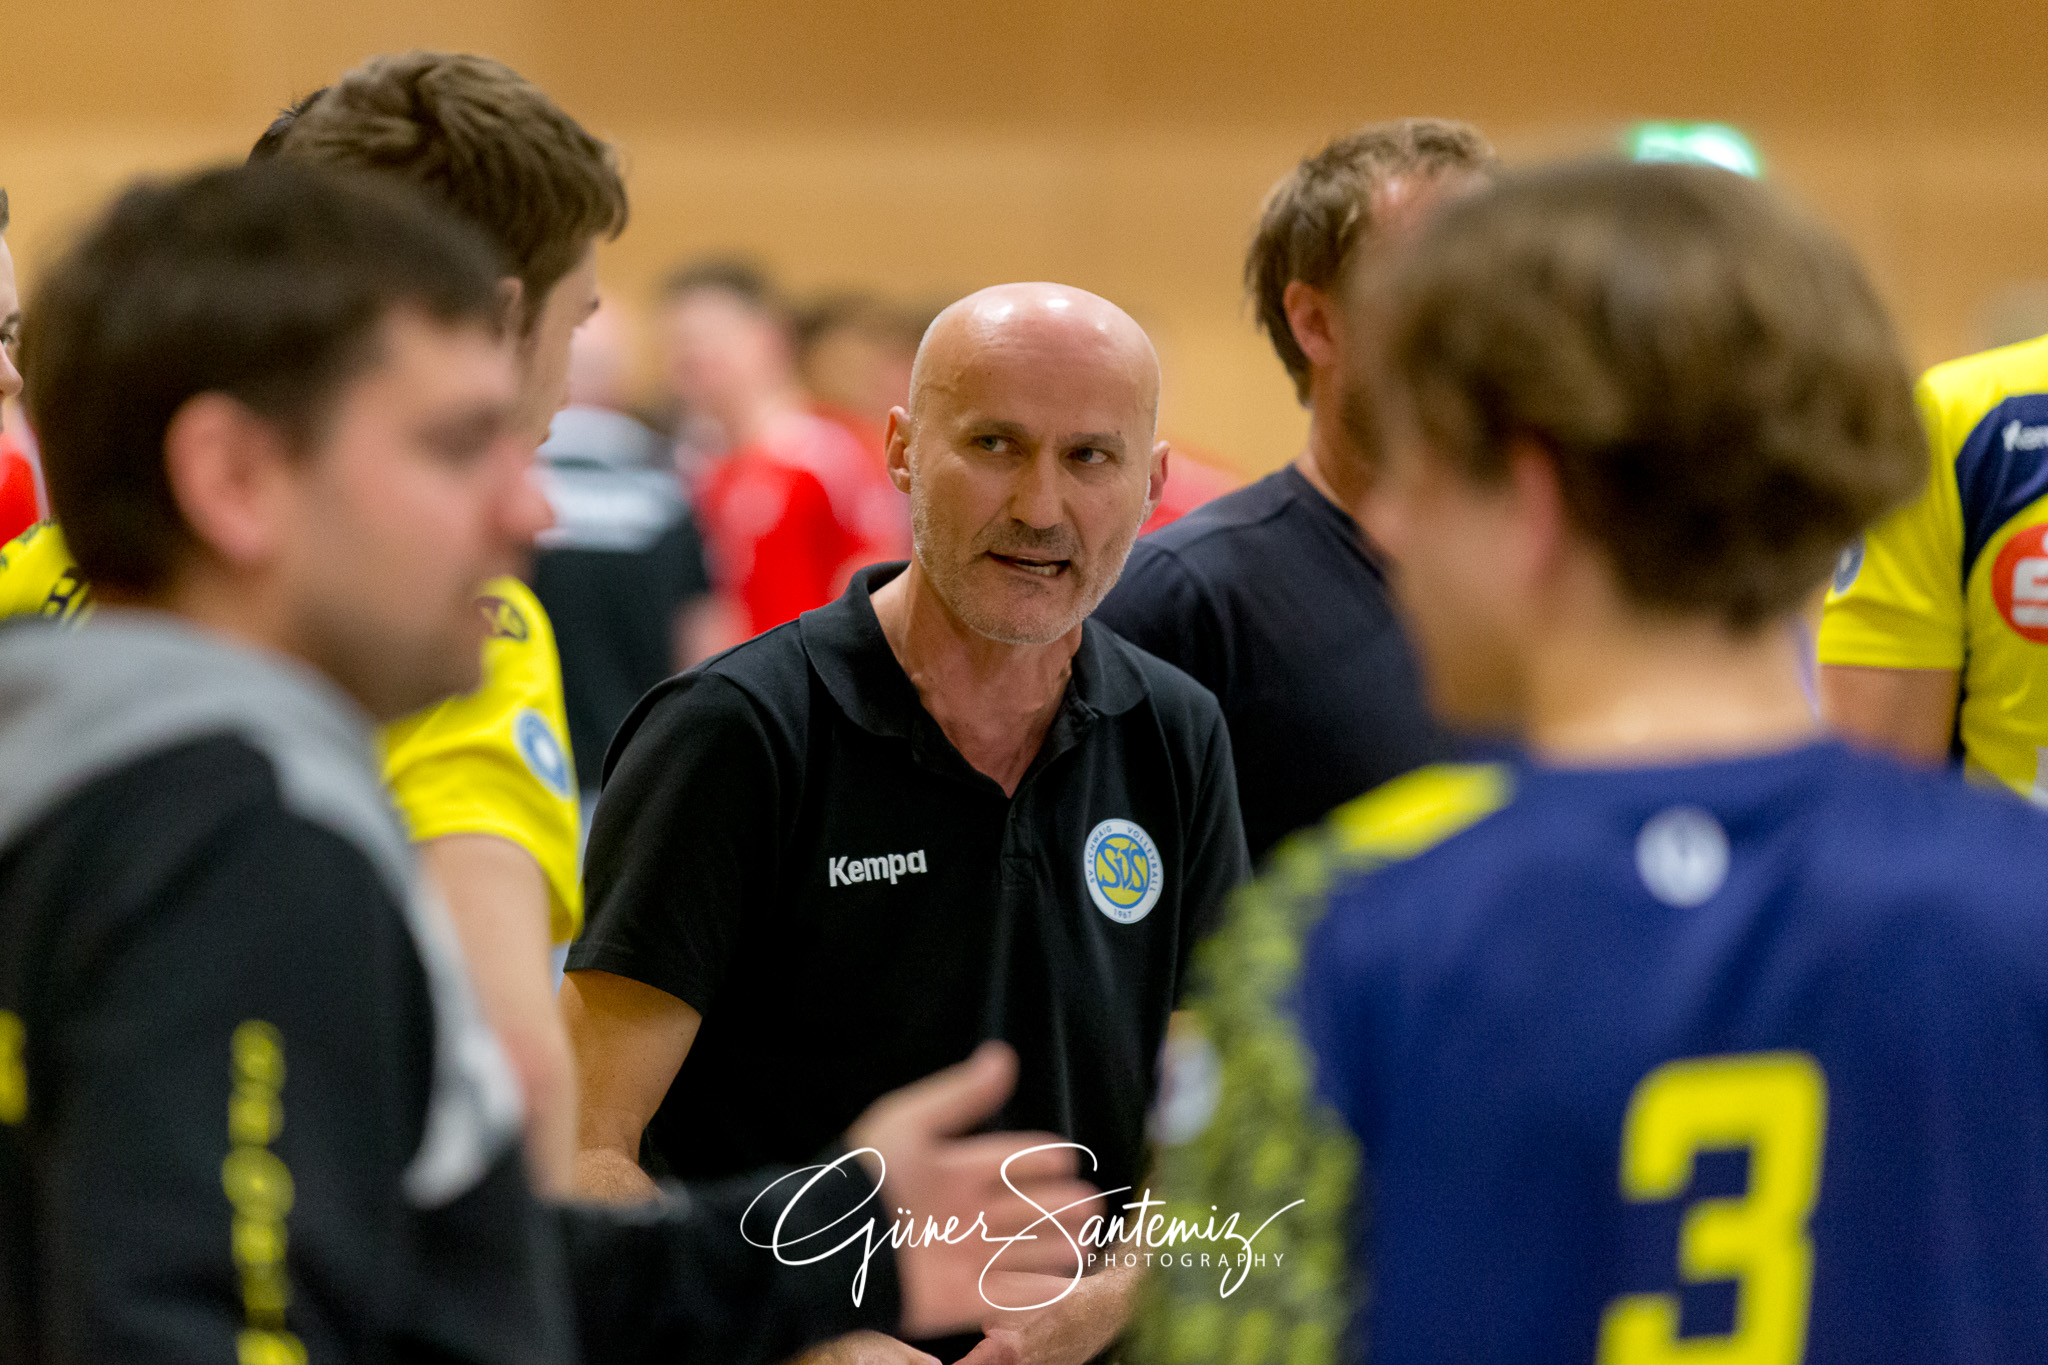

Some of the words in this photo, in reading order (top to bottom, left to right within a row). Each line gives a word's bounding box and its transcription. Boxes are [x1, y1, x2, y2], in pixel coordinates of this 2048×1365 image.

[829, 849, 928, 887] Kempa
[1087, 825, 1112, 864] SCHWAIG
[1127, 826, 1158, 891] VOLLEYBALL
[1596, 1050, 1829, 1365] 3
